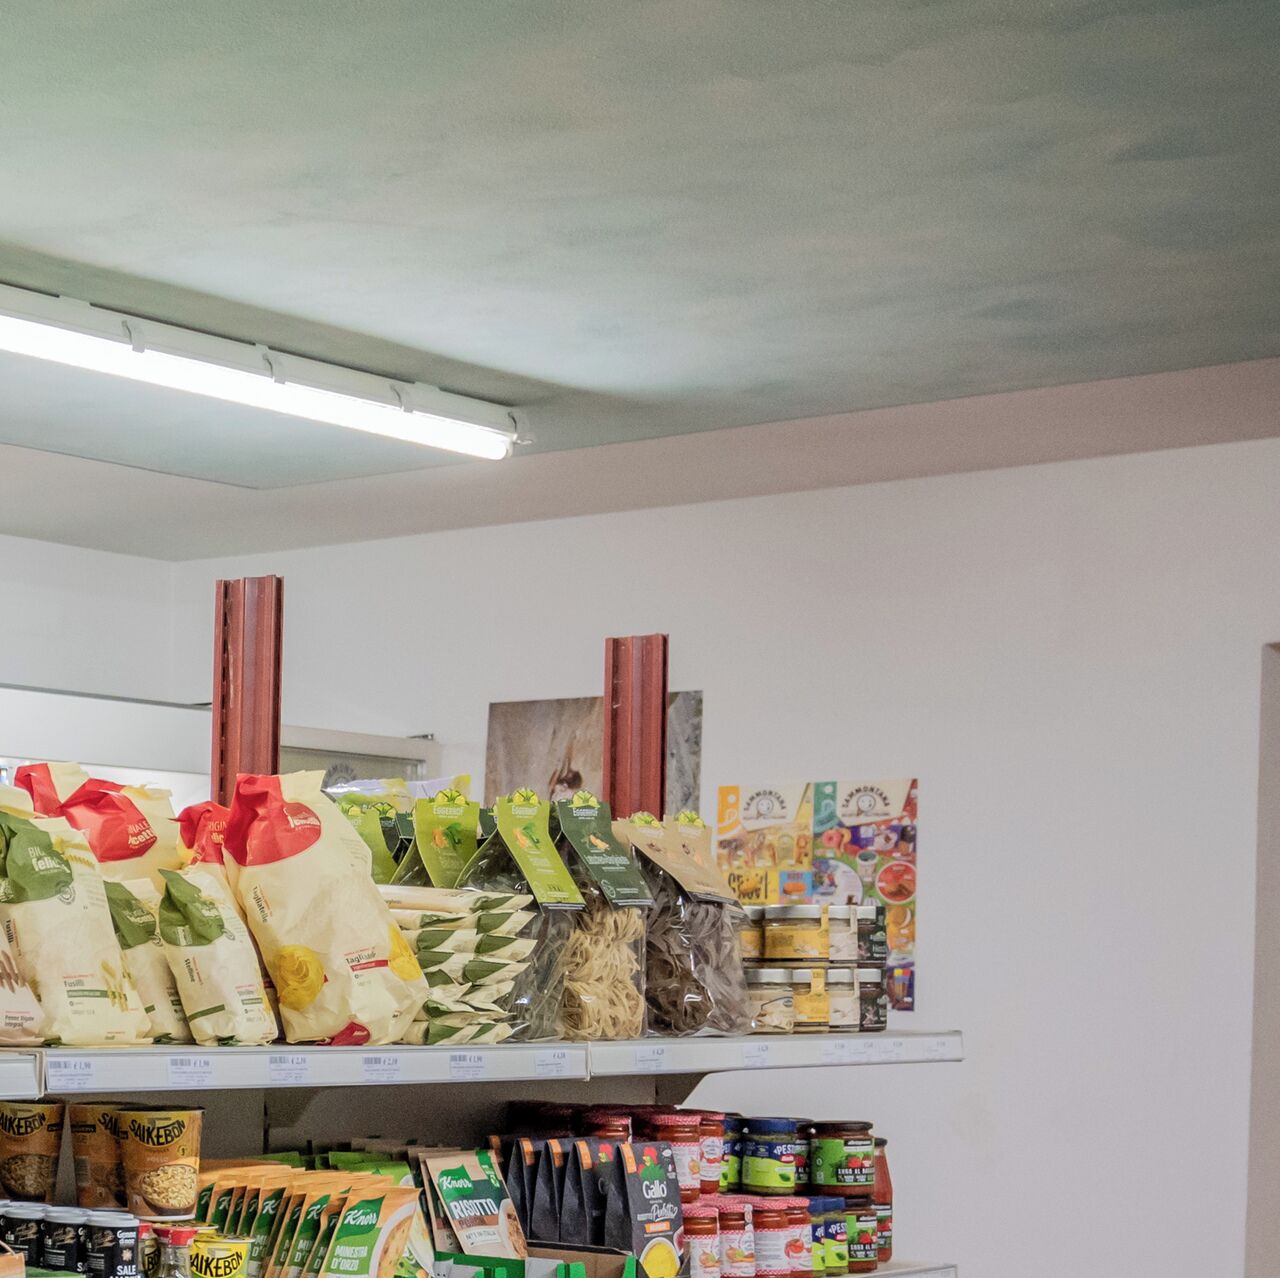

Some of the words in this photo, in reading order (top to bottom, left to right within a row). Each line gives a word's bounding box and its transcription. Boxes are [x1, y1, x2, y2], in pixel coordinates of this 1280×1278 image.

[129, 1119, 186, 1146] SAIKEBON
[441, 1176, 472, 1189] Knorr
[642, 1181, 666, 1198] Gallo
[450, 1199, 498, 1218] RISOTTO
[344, 1209, 377, 1225] Knorr
[335, 1246, 368, 1257] MINESTRA
[117, 1265, 136, 1275] SALE
[331, 1258, 359, 1271] D'ORZO
